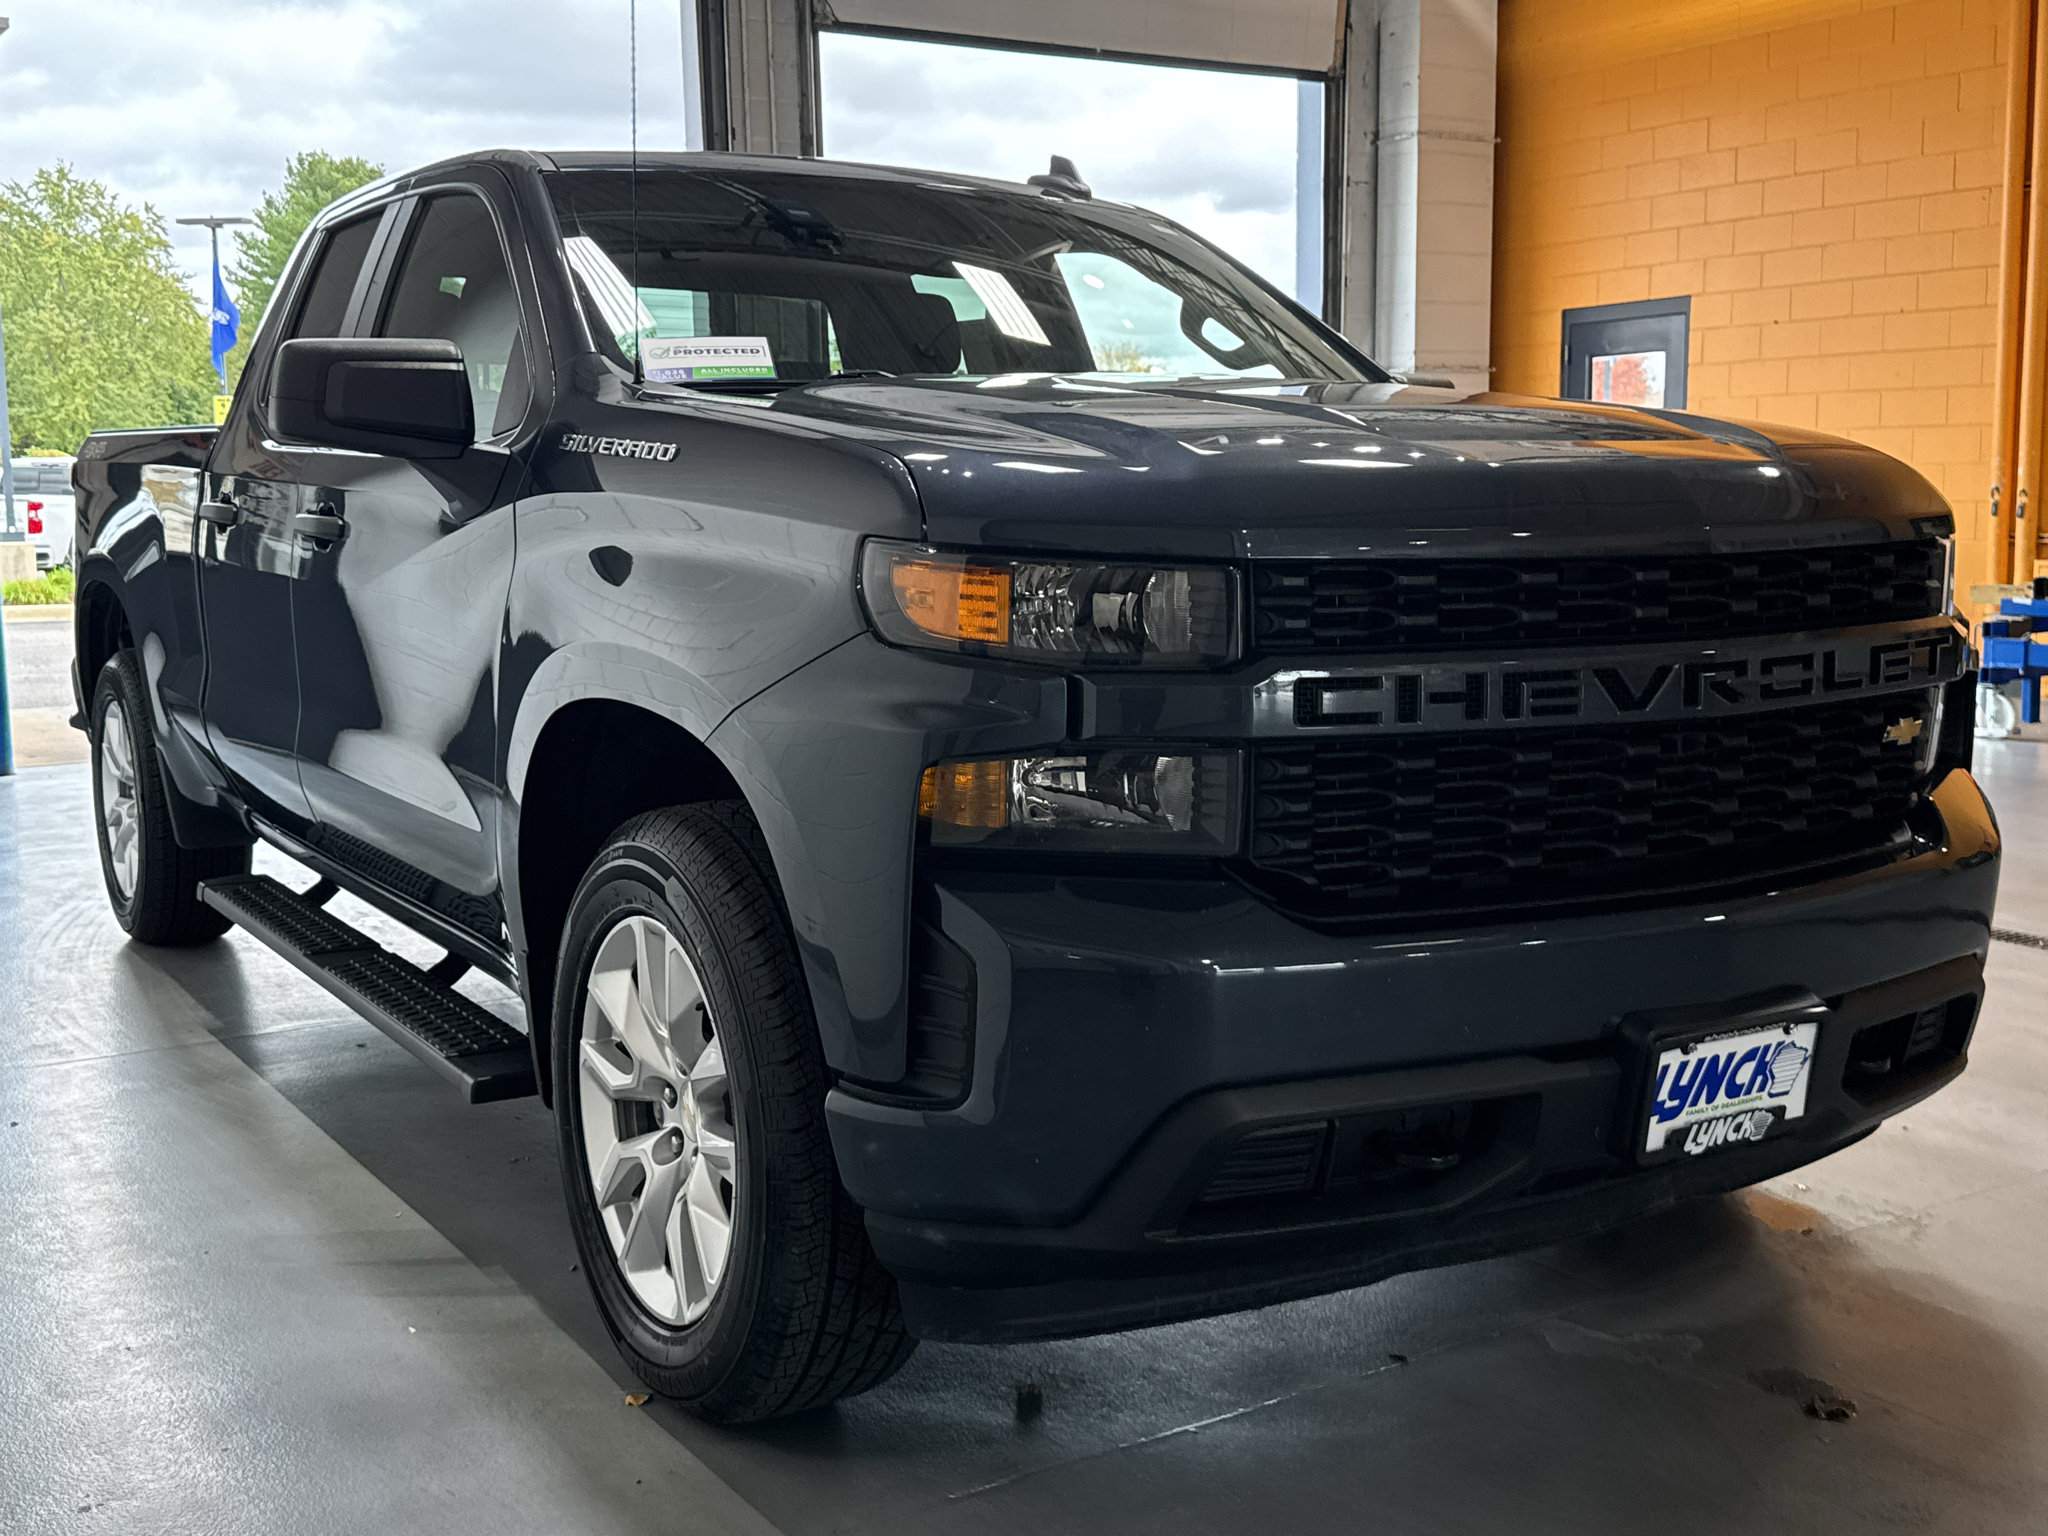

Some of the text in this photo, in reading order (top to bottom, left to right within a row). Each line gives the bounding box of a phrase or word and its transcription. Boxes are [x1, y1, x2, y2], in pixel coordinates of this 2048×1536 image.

[673, 347, 760, 355] PROTECTED
[559, 433, 677, 462] SILVERADO
[1292, 635, 1953, 728] CHEVROLET
[1650, 1040, 1786, 1125] LYNCH
[1685, 1094, 1763, 1116] FAMILY OF DEALERSHIPS
[1683, 1111, 1754, 1156] LYNCH
